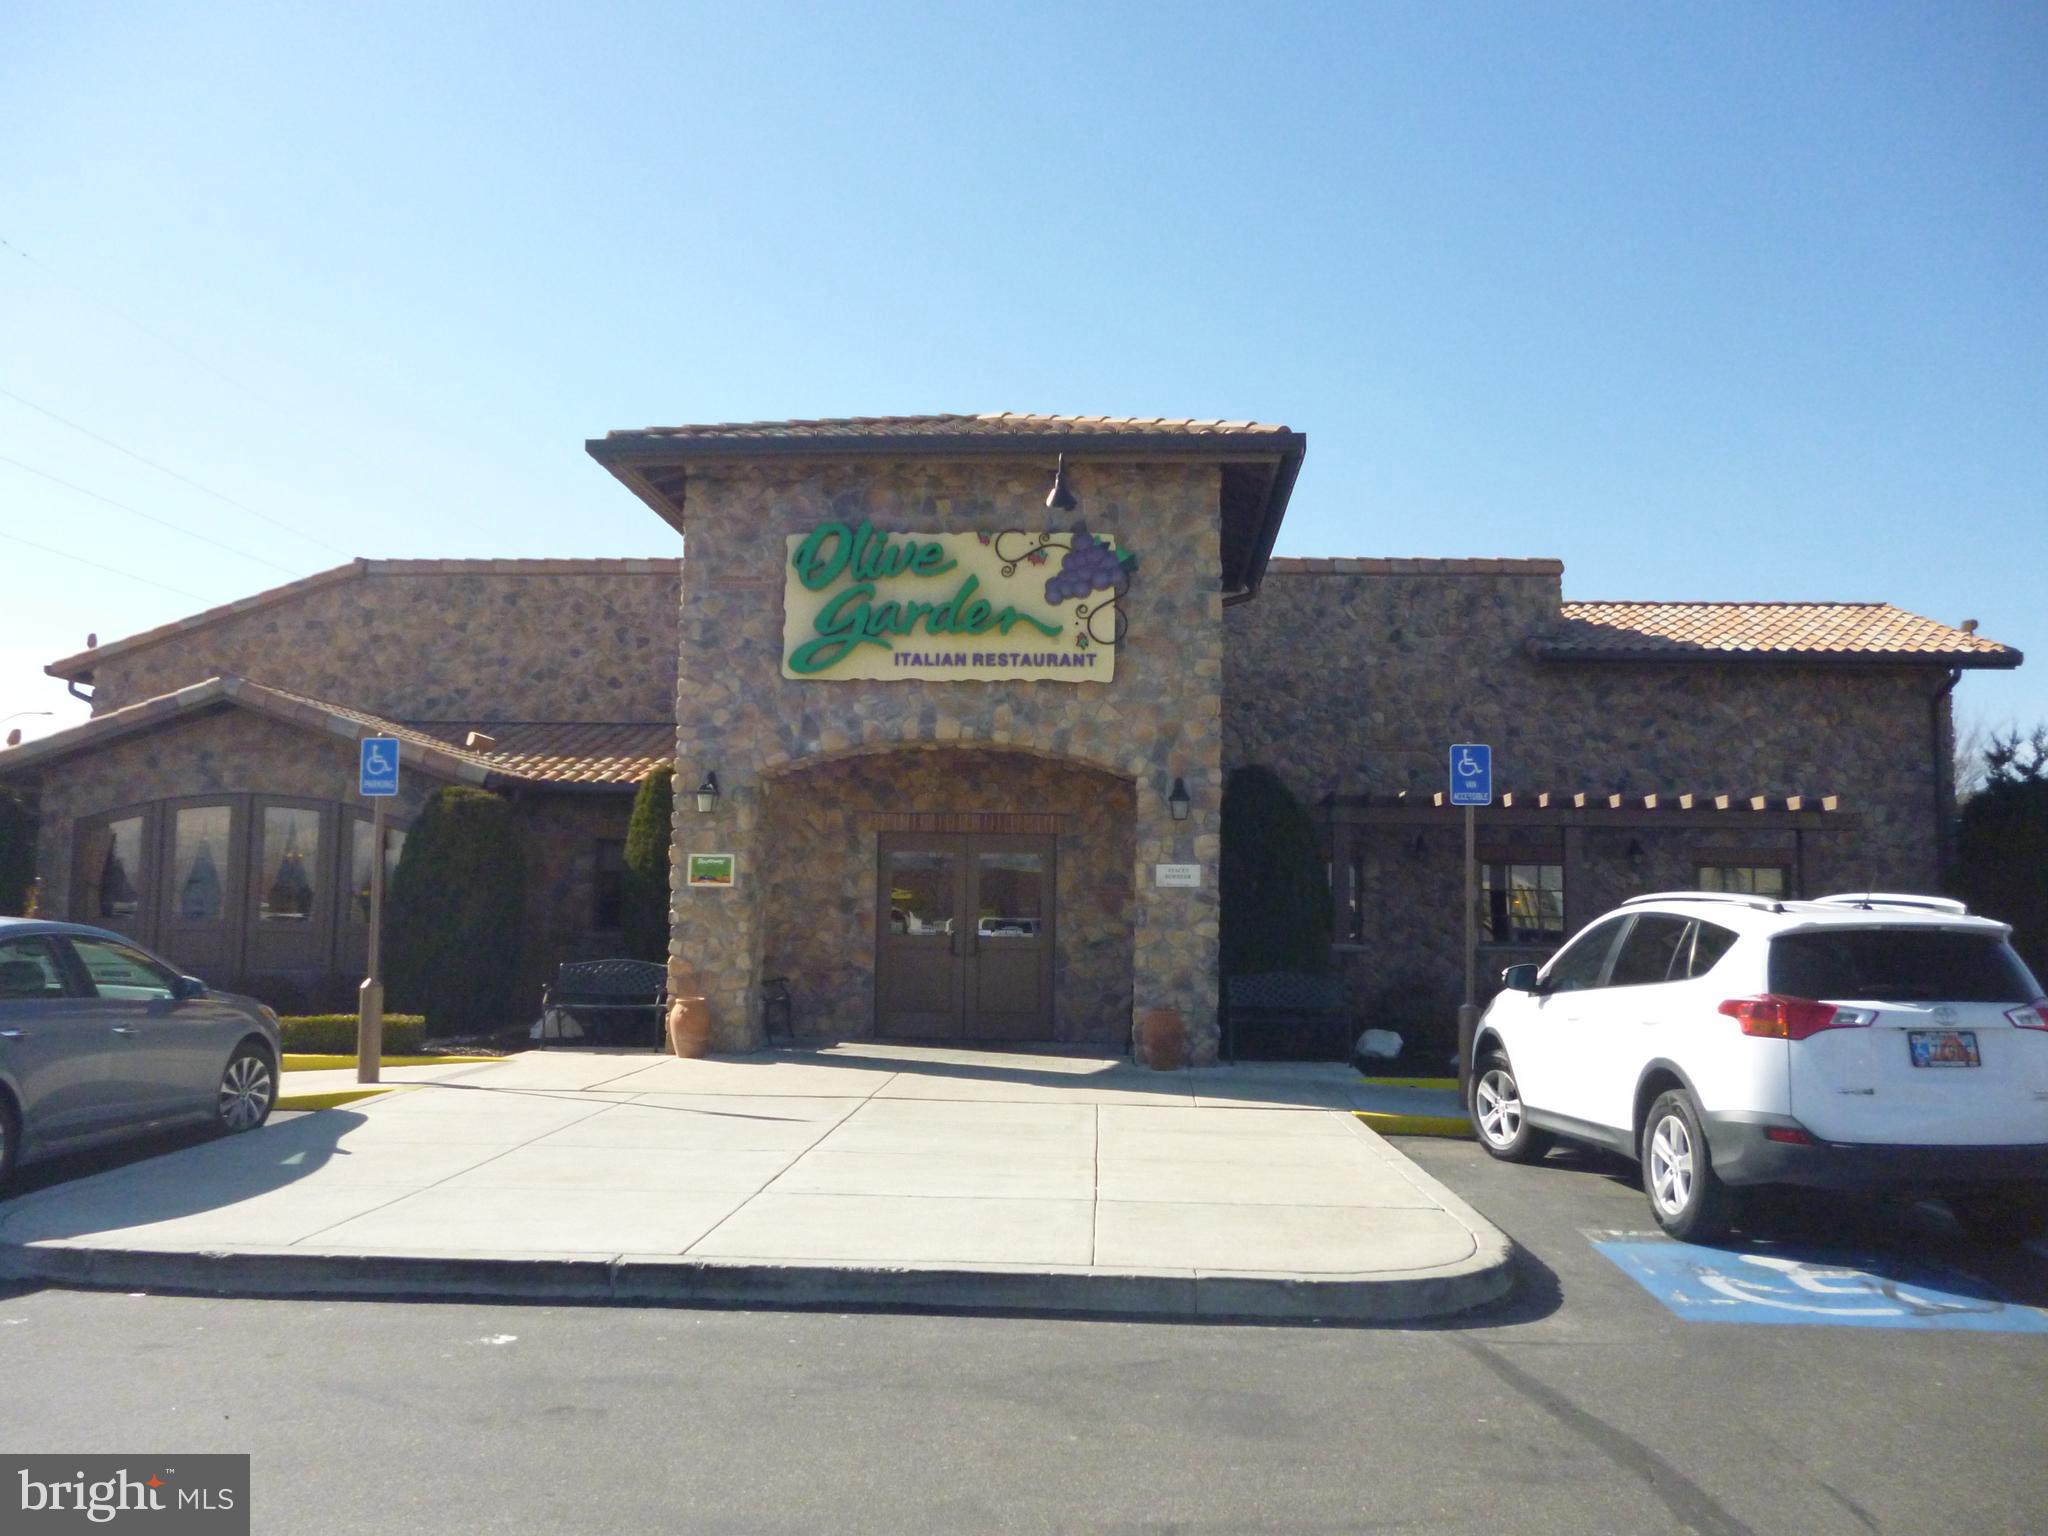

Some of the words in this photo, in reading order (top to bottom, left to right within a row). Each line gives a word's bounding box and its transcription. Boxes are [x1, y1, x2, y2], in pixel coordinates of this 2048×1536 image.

[792, 519, 958, 592] Olive
[788, 573, 1064, 674] Garden
[894, 652, 967, 667] ITALIAN
[972, 652, 1097, 667] RESTAURANT
